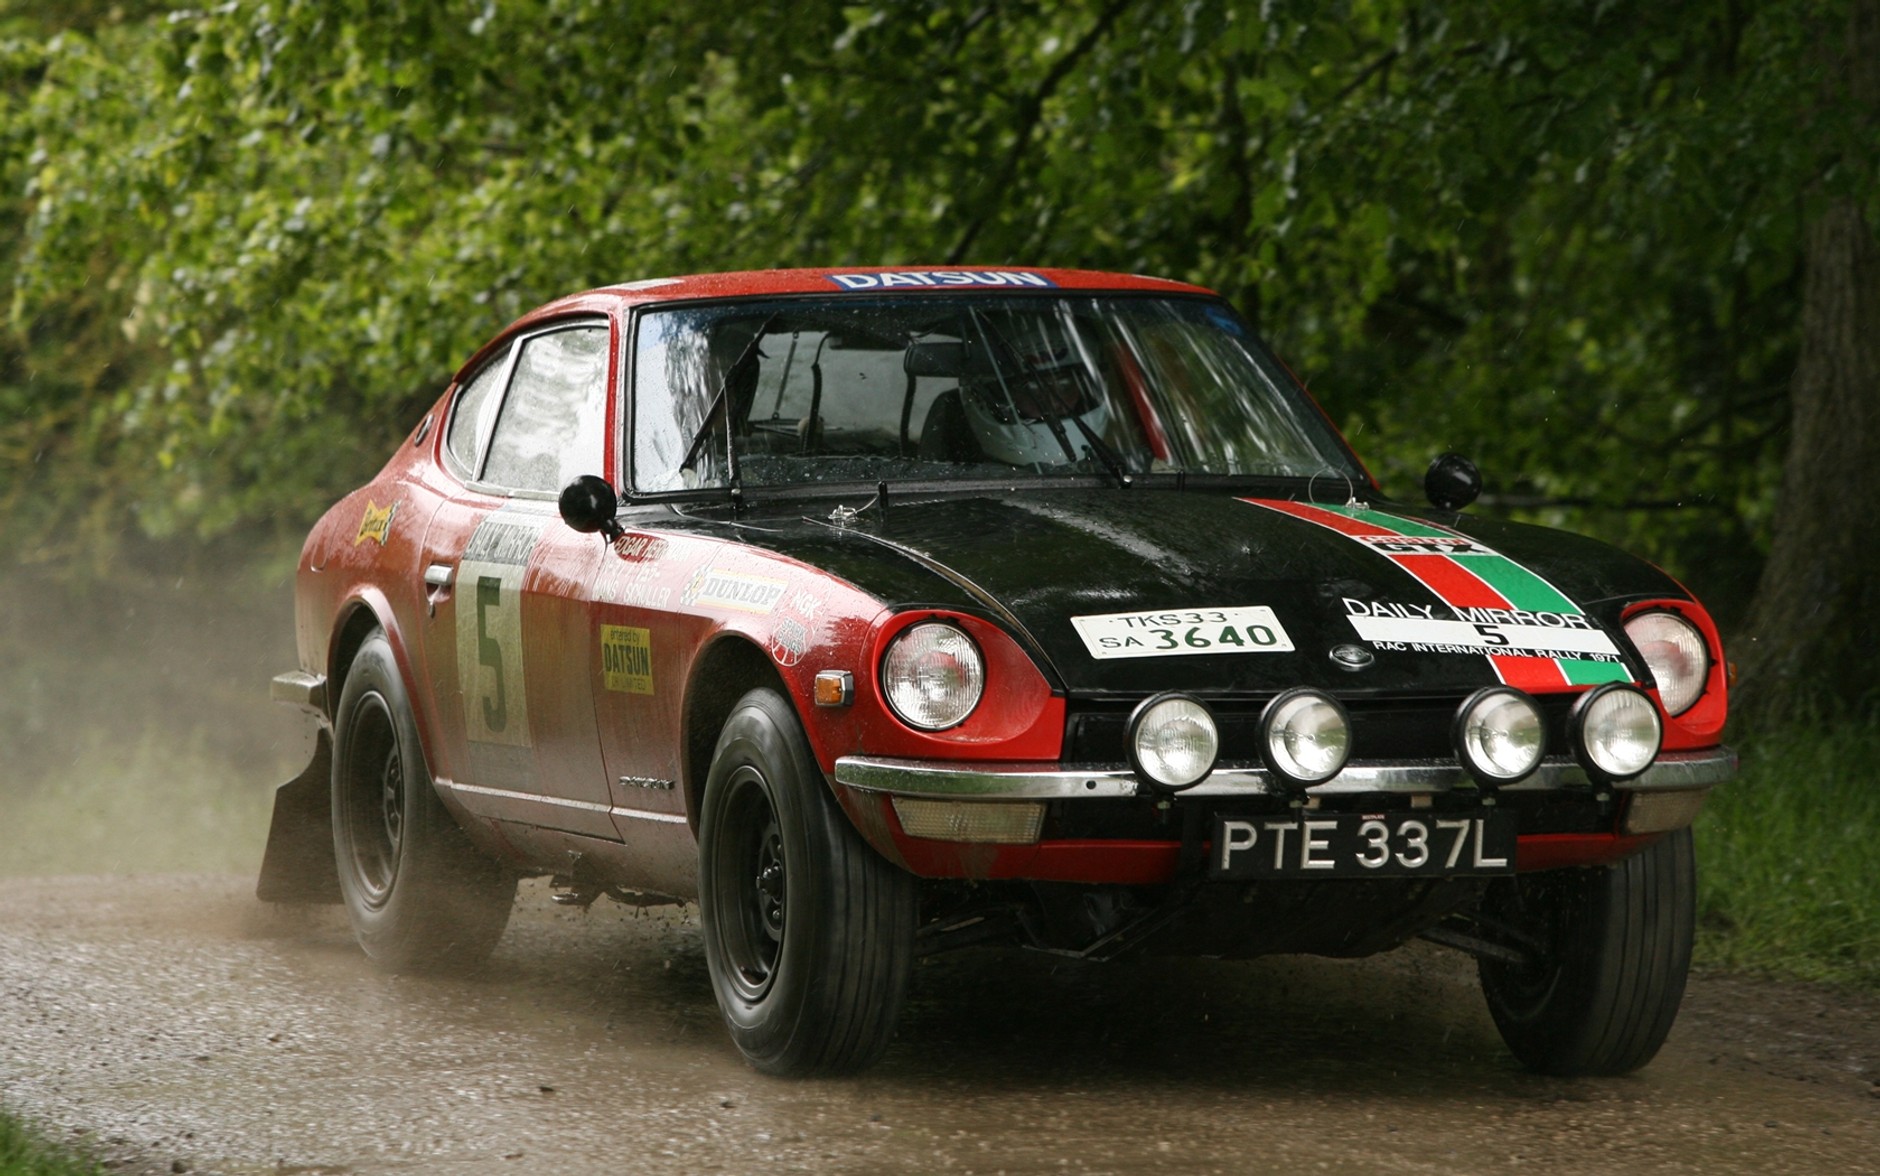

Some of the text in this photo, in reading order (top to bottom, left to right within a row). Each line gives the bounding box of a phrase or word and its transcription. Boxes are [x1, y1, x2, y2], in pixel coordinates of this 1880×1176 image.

[832, 271, 1048, 289] DATSUN
[615, 535, 646, 557] EDGAR
[703, 577, 781, 606] DUNLOP
[790, 589, 822, 620] NGK
[781, 616, 807, 638] SPARK
[1342, 597, 1593, 630] DAILY MIRROR
[1099, 625, 1277, 650] SA 3640
[1473, 623, 1510, 646] 5
[477, 576, 508, 733] 5
[604, 643, 649, 676] DATSUN
[1372, 640, 1620, 662] RAC INTERNATIONAL RALLY 1971
[1221, 818, 1507, 870] PTE 337L
